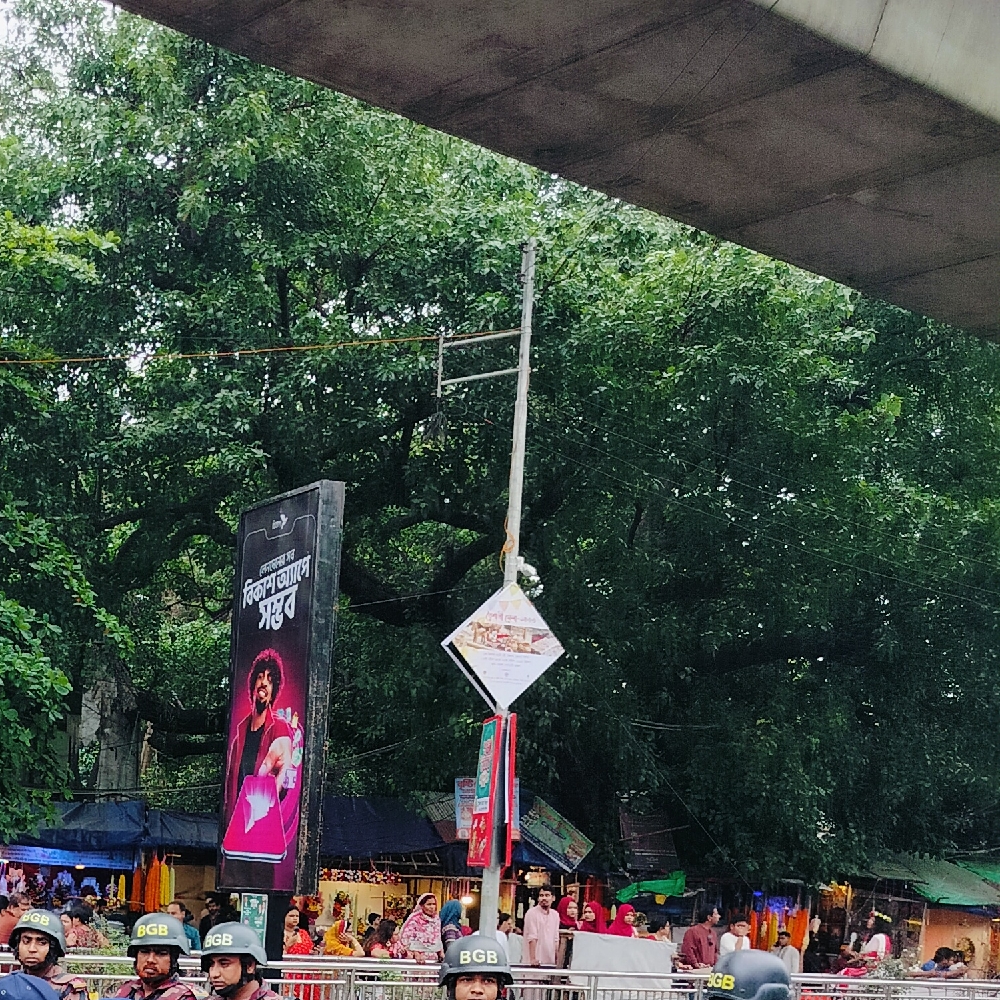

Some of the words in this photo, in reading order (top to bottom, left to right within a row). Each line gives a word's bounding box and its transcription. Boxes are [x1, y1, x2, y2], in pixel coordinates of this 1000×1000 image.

[242, 572, 278, 609] বিকাশ
[276, 554, 312, 589] অ্যাপে
[258, 583, 299, 631] সম্ভব
[21, 912, 50, 926] BGB
[137, 923, 168, 938] BGB
[203, 933, 233, 948] BGB
[460, 949, 498, 965] BGB
